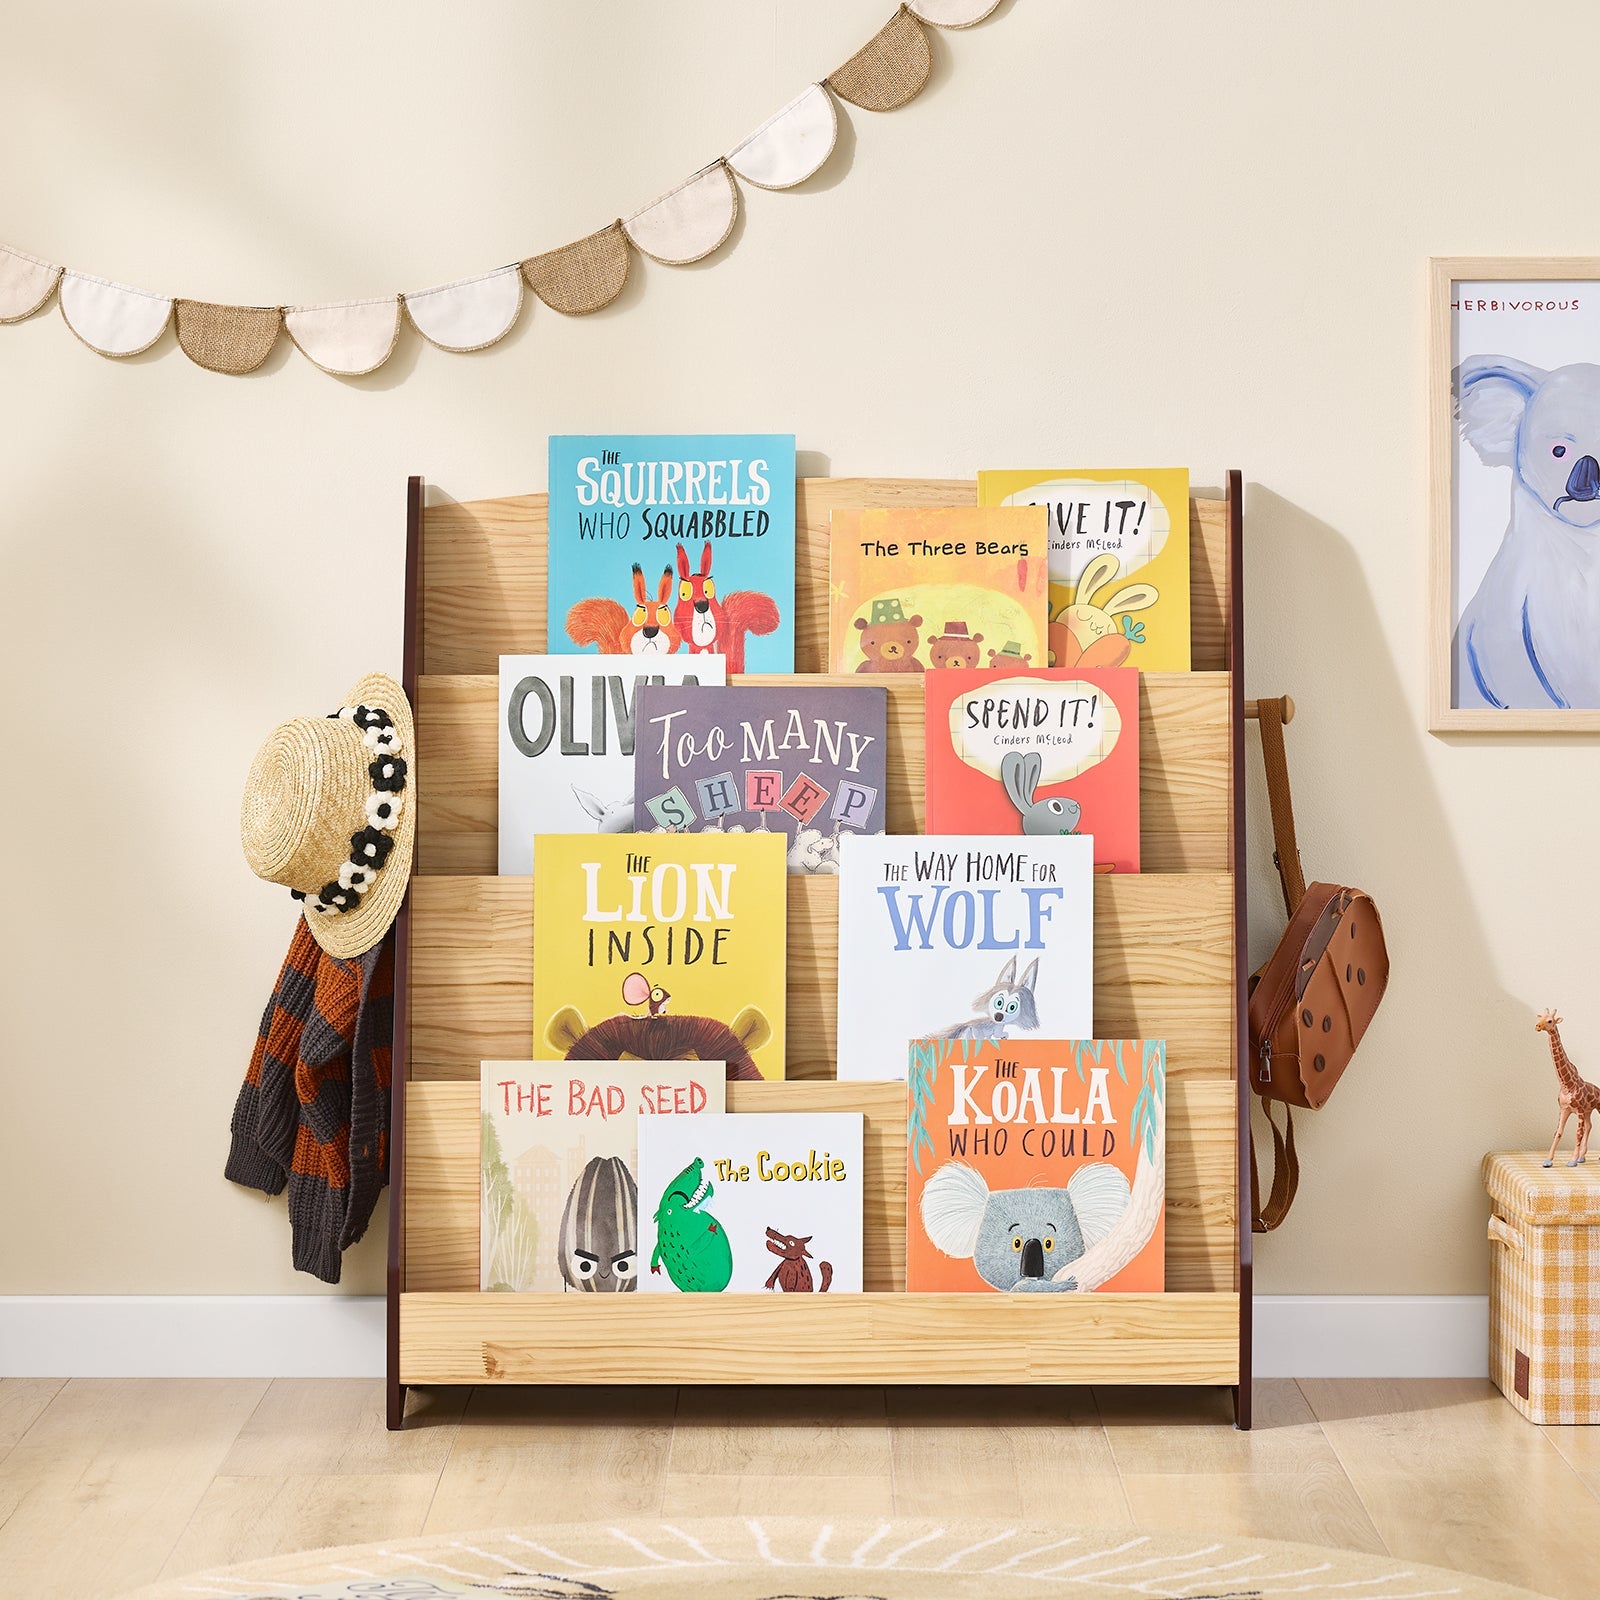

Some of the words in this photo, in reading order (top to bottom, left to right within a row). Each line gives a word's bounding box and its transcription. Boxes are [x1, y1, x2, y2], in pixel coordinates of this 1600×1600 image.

[601, 450, 621, 465] THE
[575, 457, 771, 506] SQUIRRELS
[578, 511, 630, 540] WHO
[642, 508, 770, 540] SQUABBLED
[1104, 501, 1147, 536] IT!
[861, 542, 899, 556] The
[907, 540, 966, 556] Three
[975, 541, 1029, 557] Bears
[507, 674, 700, 757] OLIV
[966, 698, 1049, 729] SPEND
[1059, 694, 1098, 729] IT!
[739, 709, 875, 773] MANY
[993, 734, 1030, 745] Cinders
[1035, 733, 1073, 746] McLeod
[626, 853, 652, 873] THE
[884, 863, 909, 882] THE
[914, 851, 958, 883] WAY
[966, 852, 1028, 883] HOME
[1032, 863, 1057, 883] FOR
[581, 862, 737, 922] LION
[877, 885, 1064, 951] WOLF
[588, 925, 731, 967] INSIDE
[994, 1058, 1019, 1078] THE
[497, 1080, 553, 1116] THE
[567, 1079, 626, 1121] BAD
[638, 1080, 708, 1116] SEED
[947, 1064, 1118, 1125] KOALA
[949, 1128, 1008, 1157] WHO
[1022, 1128, 1116, 1158] COULD
[713, 1159, 750, 1182] The
[756, 1150, 847, 1182] Cookie
